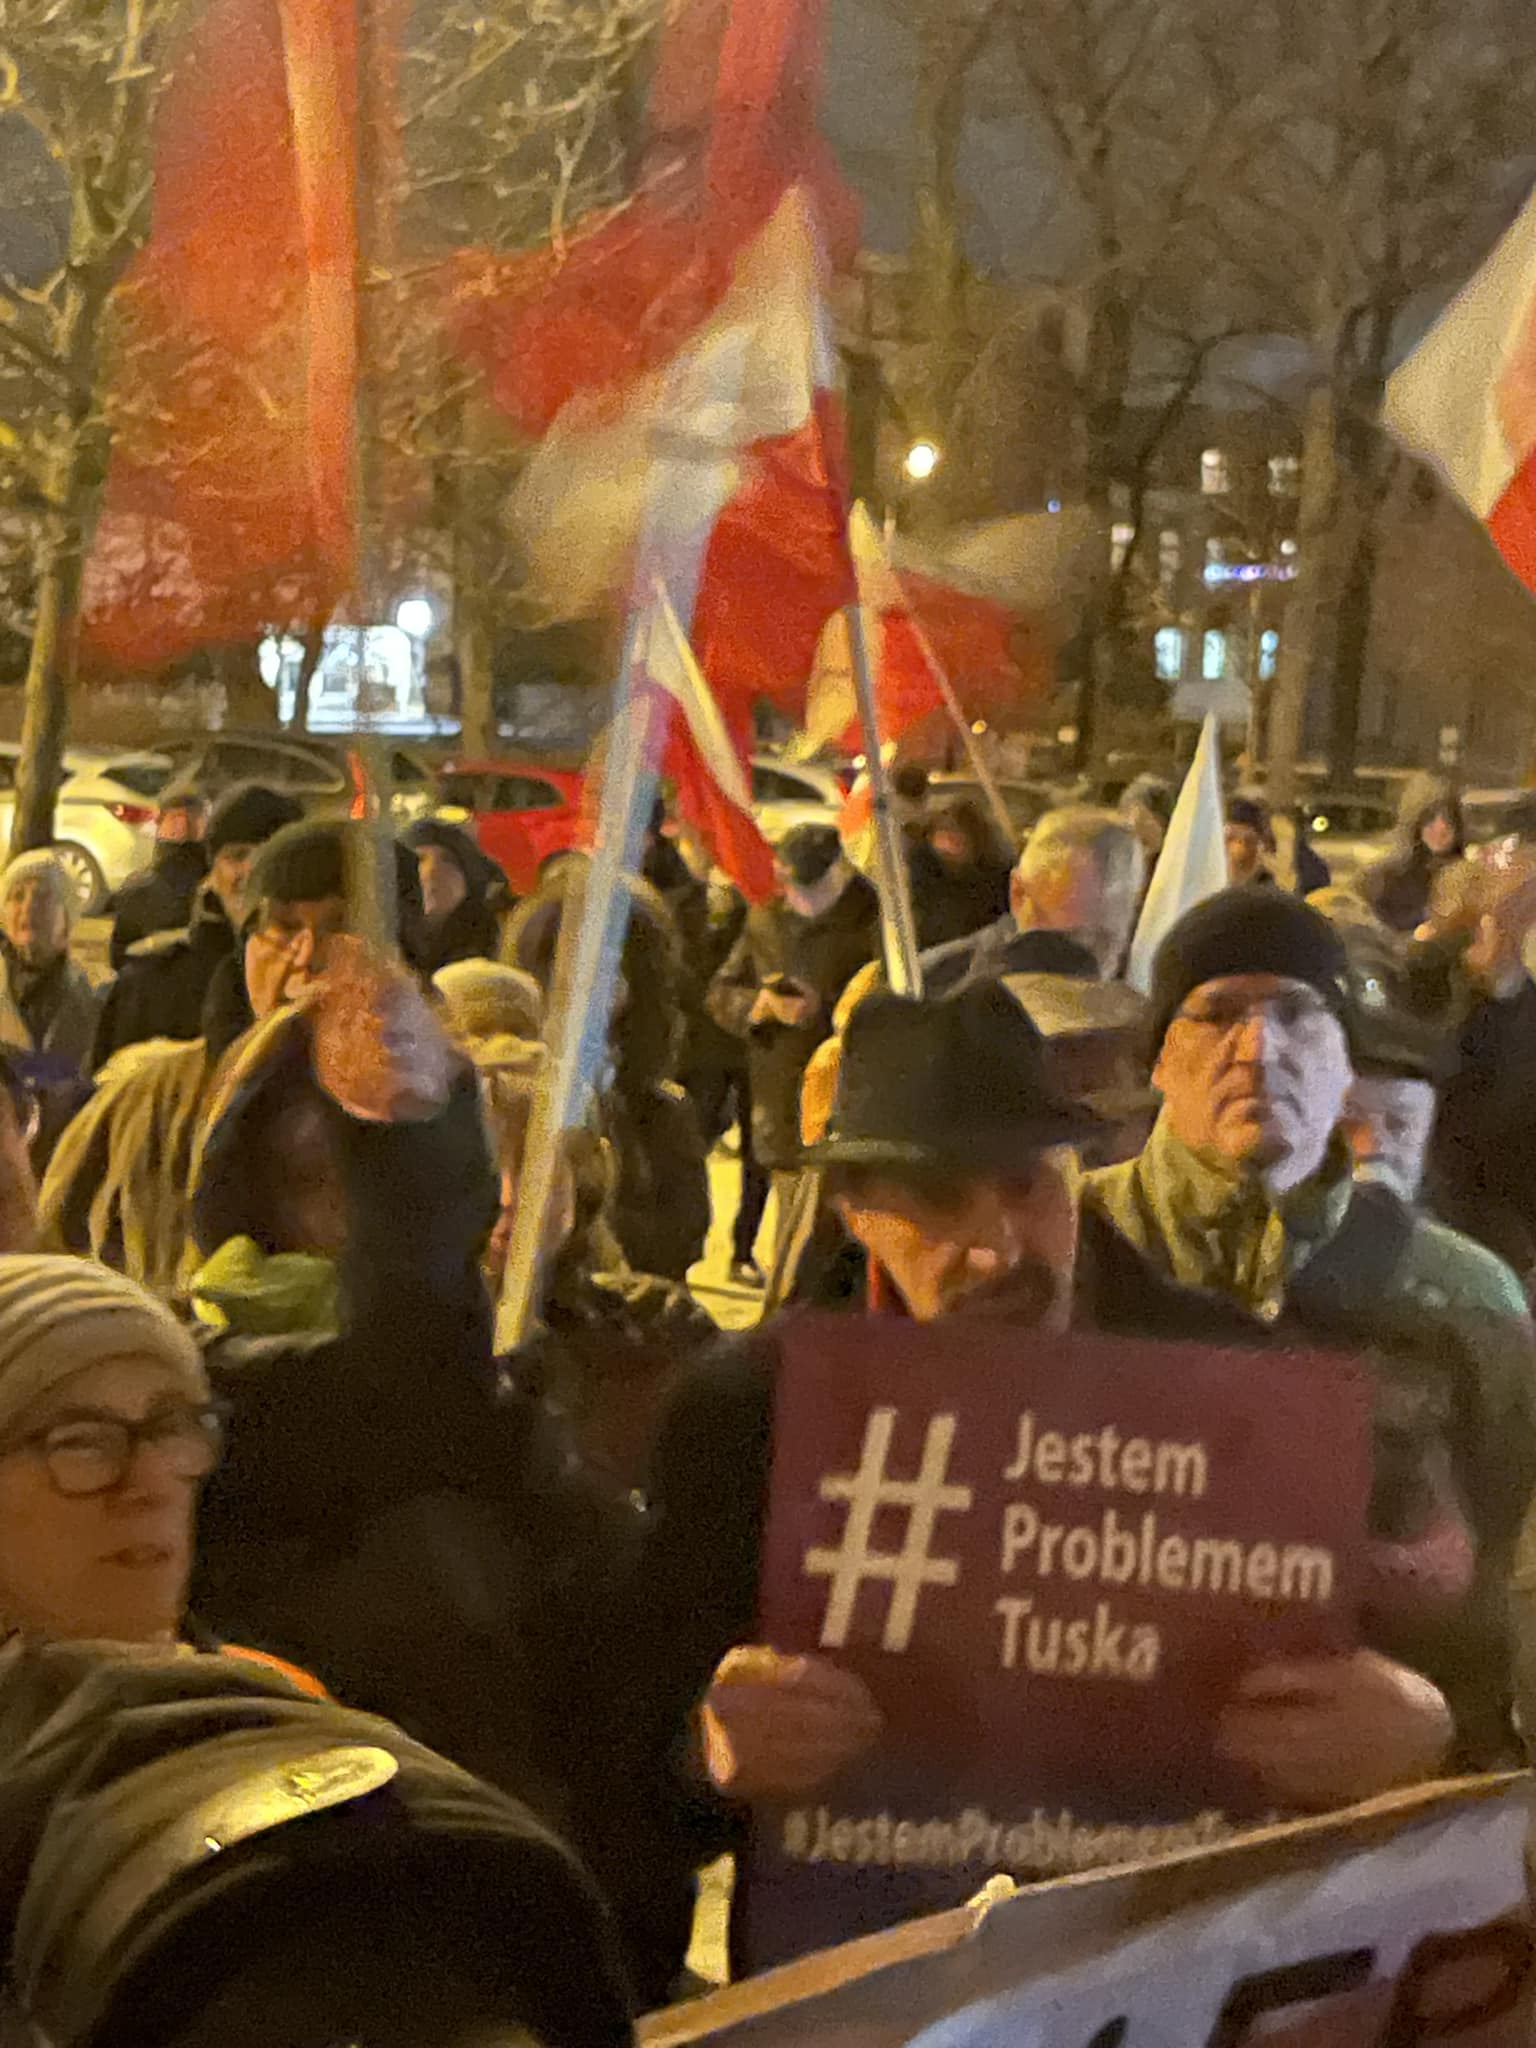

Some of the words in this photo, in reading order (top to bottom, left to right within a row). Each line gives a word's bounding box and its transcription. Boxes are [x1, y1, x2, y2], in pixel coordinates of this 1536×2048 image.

[1004, 1409, 1208, 1497] Jestem
[1000, 1502, 1333, 1601] Problemem
[996, 1598, 1161, 1681] Tuska
